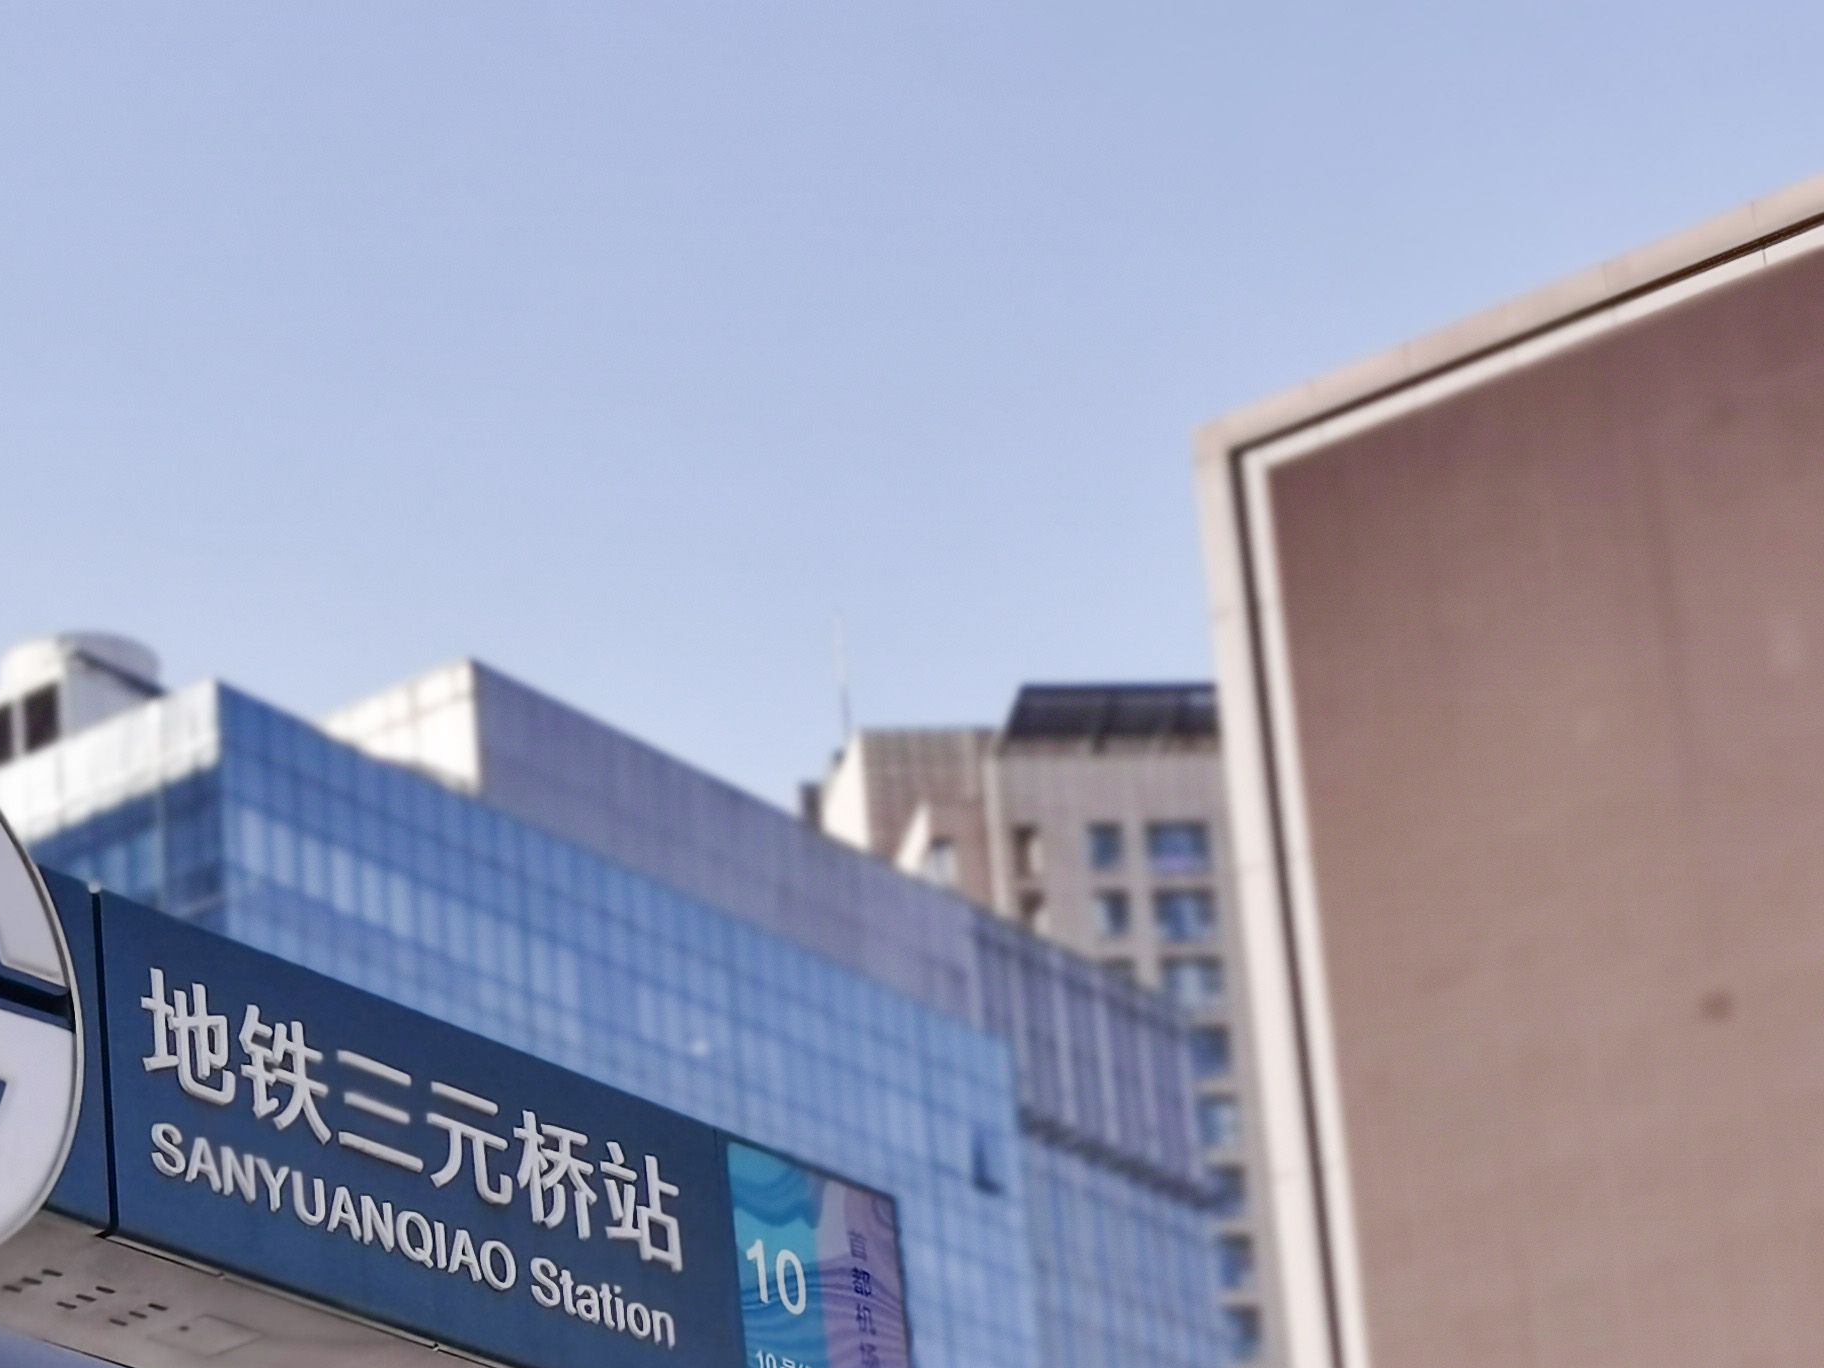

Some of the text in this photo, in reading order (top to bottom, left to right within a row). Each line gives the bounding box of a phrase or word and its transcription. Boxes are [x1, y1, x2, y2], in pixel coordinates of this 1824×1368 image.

[140, 966, 684, 1274] 地铁三元桥站
[151, 1122, 677, 1350] SANYUANQIAO Station
[746, 1238, 807, 1316] 10
